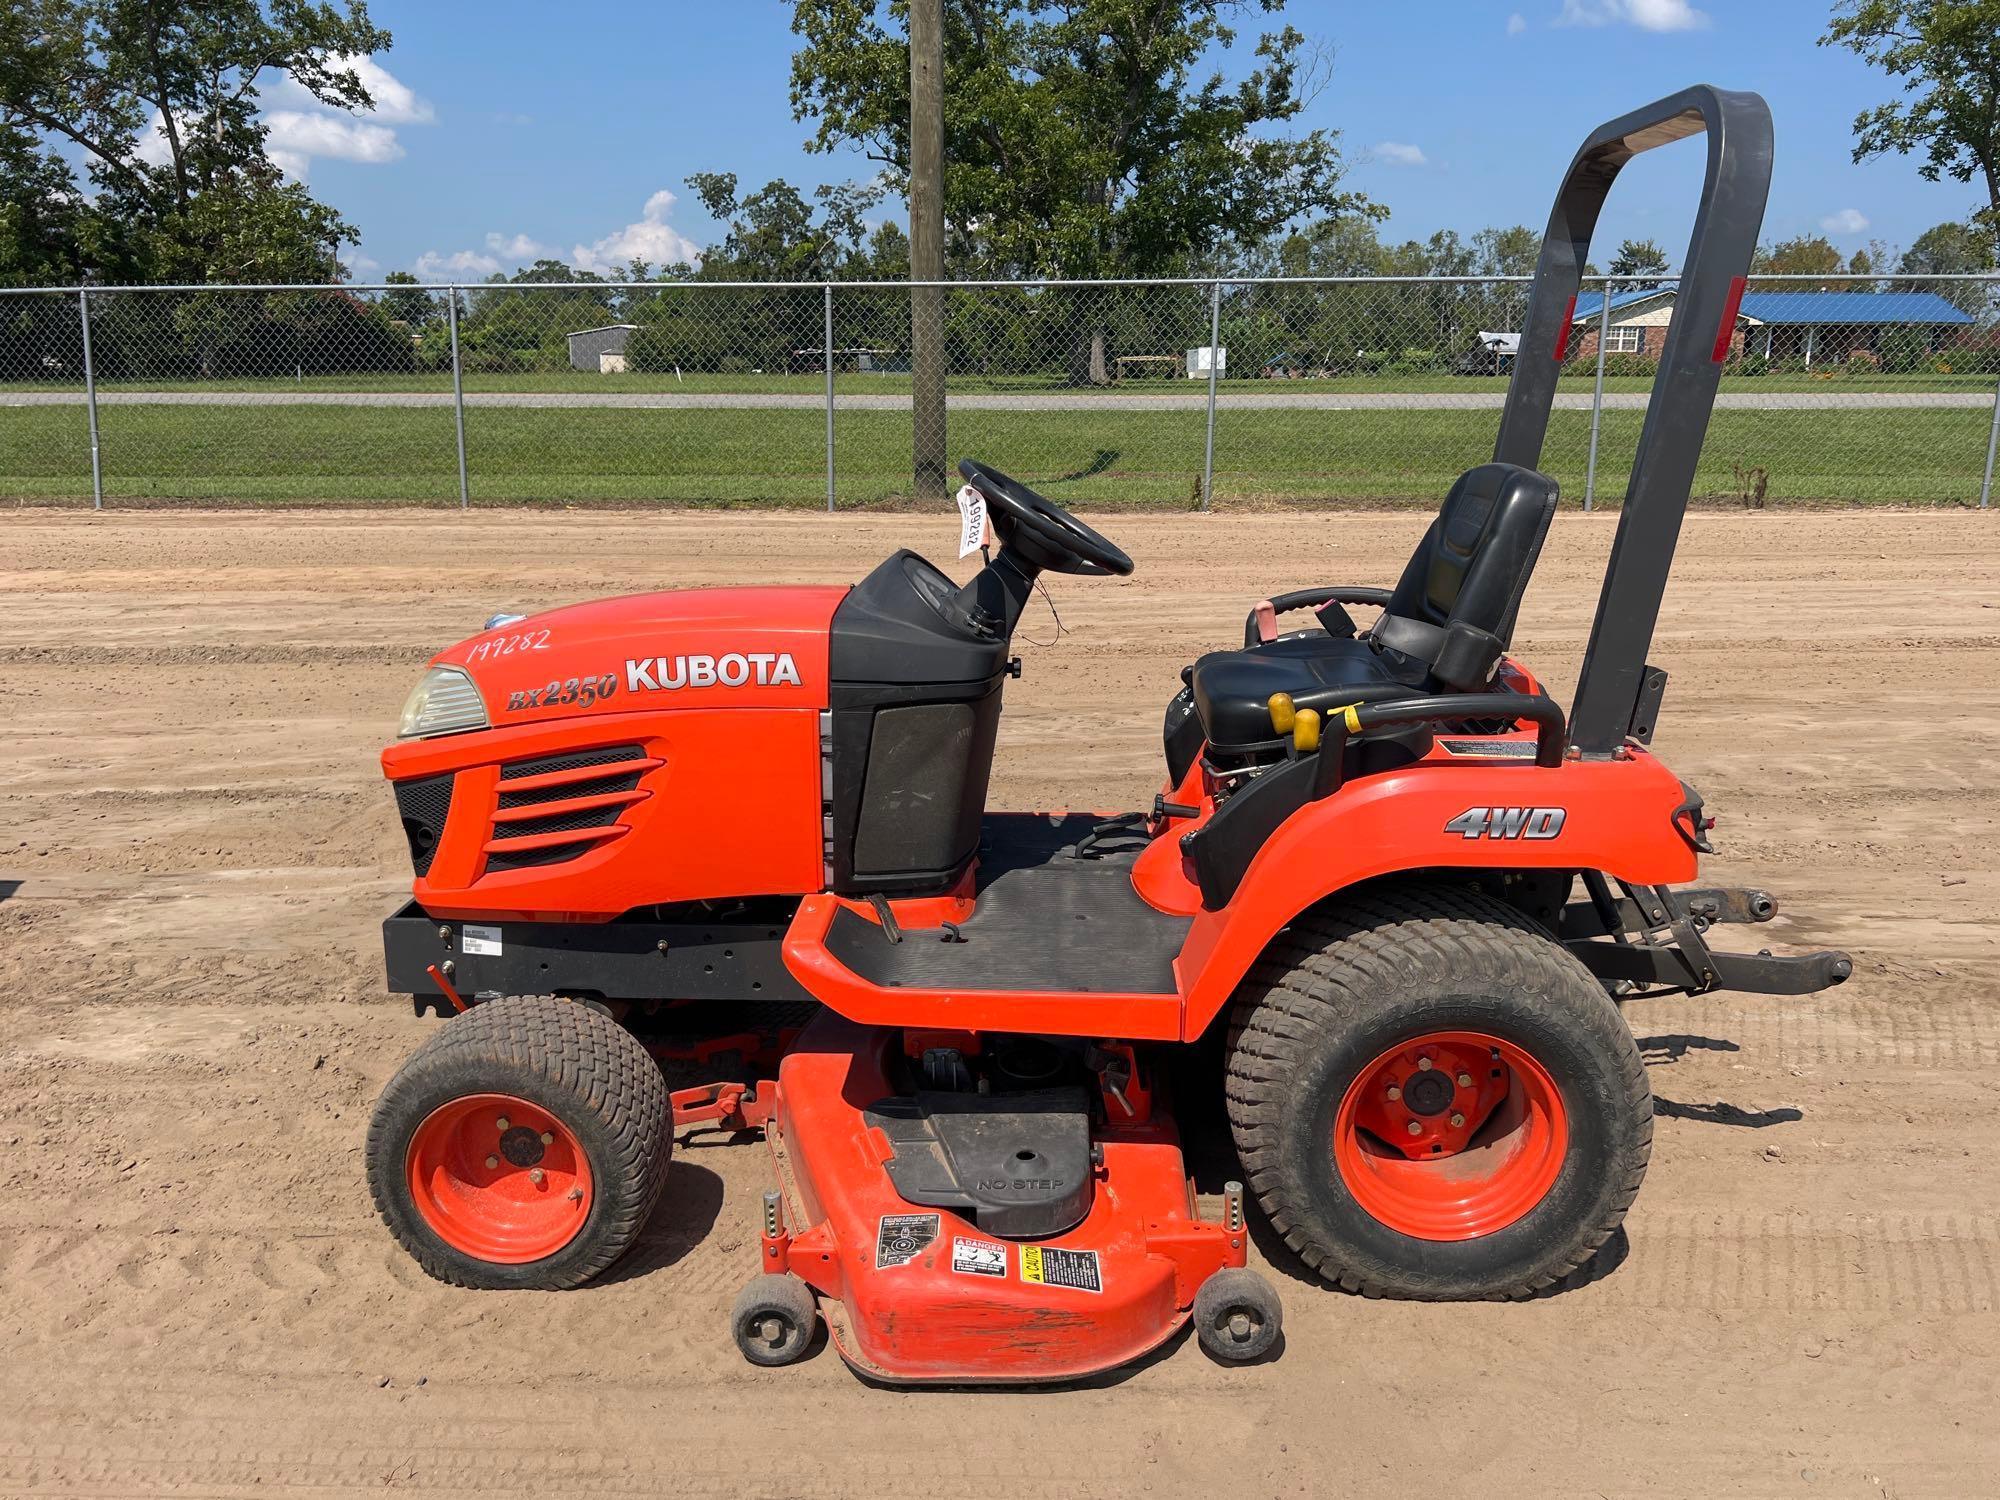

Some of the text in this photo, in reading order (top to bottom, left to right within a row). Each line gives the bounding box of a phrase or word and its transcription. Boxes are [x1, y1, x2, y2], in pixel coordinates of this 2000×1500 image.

[966, 498, 981, 547] 199282
[466, 628, 552, 663] 199282
[625, 653, 804, 693] KUBOTA
[506, 672, 619, 712] BX2350
[1444, 806, 1568, 840] 4WD
[977, 1178, 1065, 1191] NO STEP
[965, 1239, 1004, 1252] DANGER
